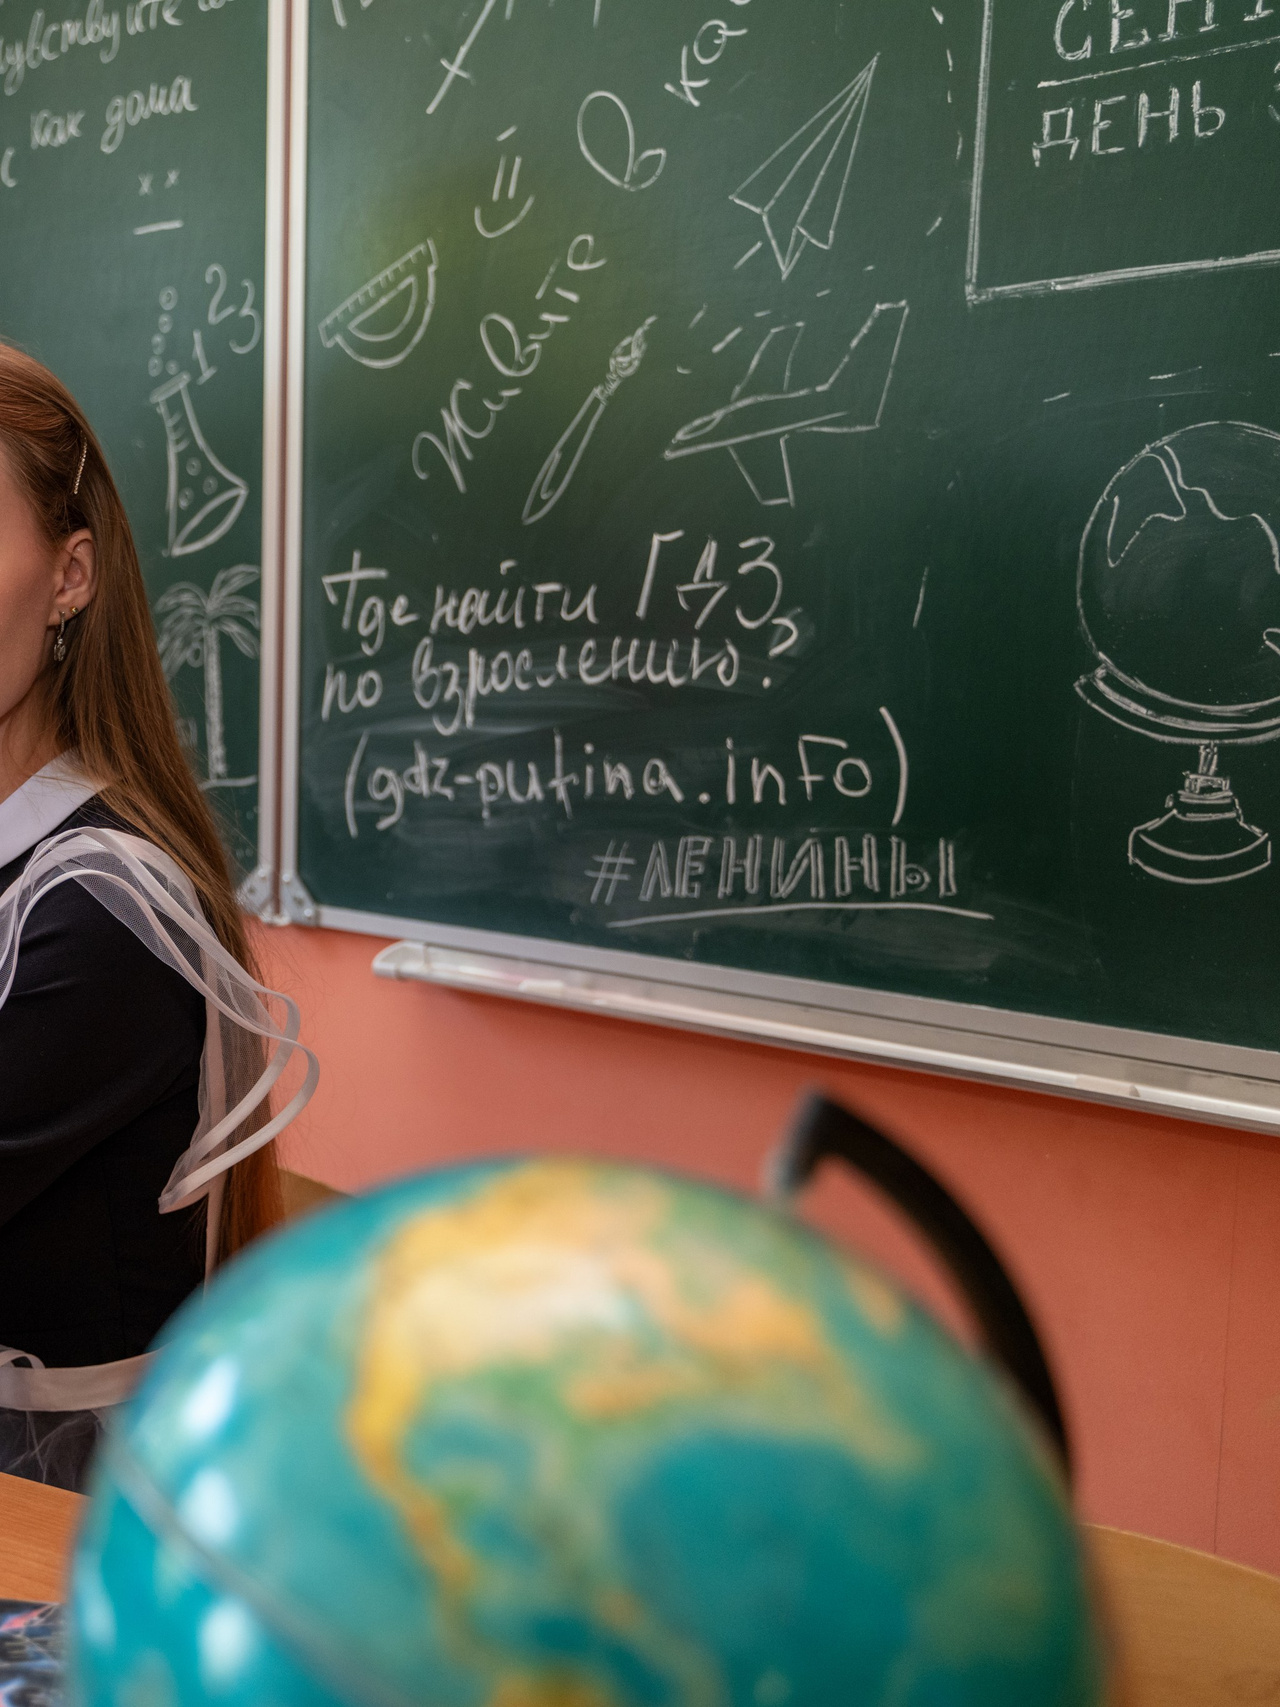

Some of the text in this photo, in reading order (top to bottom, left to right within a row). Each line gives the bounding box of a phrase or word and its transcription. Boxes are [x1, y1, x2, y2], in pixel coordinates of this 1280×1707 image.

[30, 74, 199, 153] как дома
[1032, 80, 1226, 168] ДЕНЬ
[322, 529, 784, 656] Где найти ГДЗ
[321, 661, 384, 722] по
[583, 829, 958, 906] #ЛЕНИНЫ
